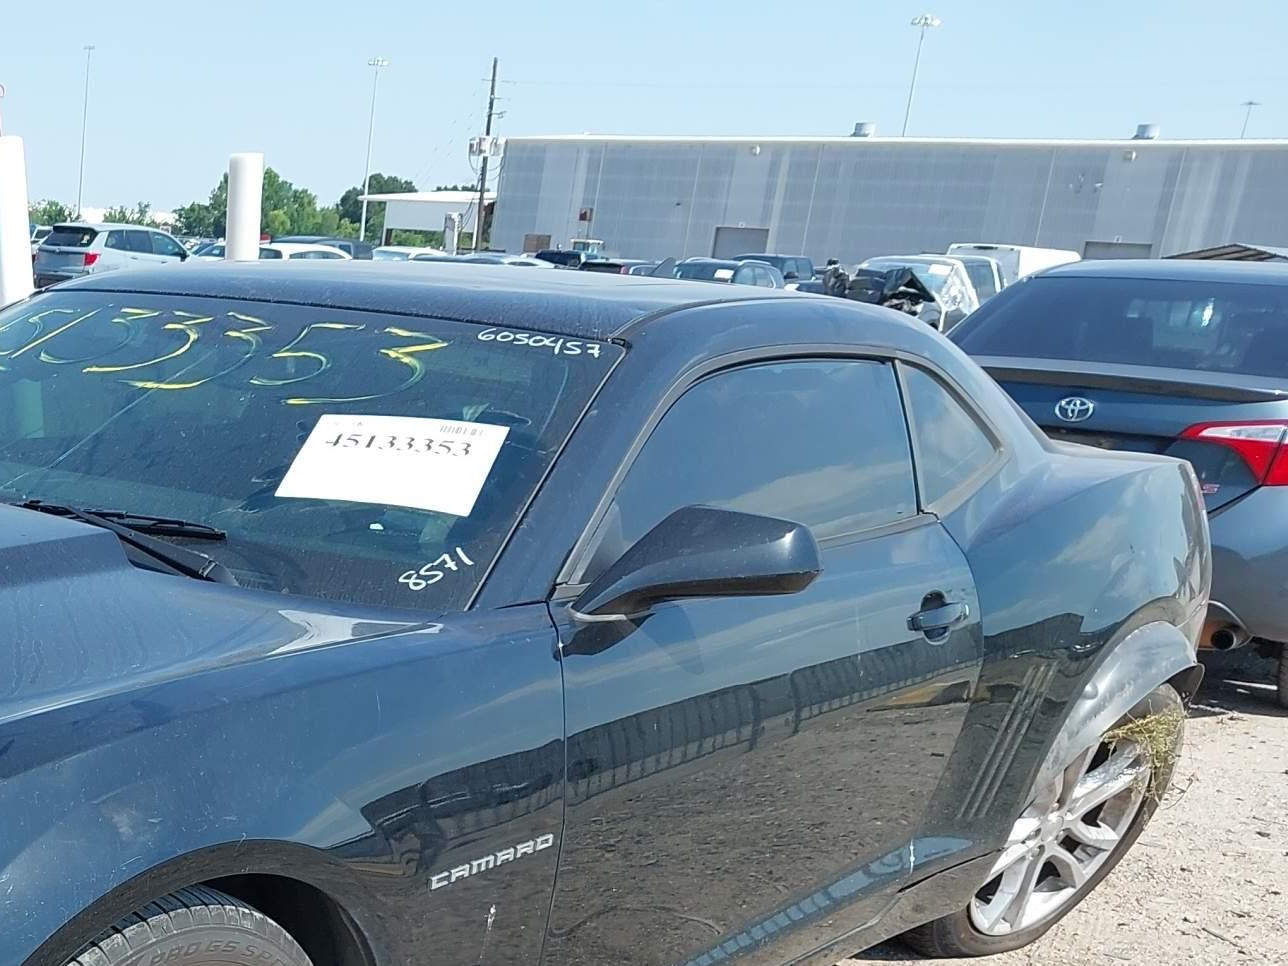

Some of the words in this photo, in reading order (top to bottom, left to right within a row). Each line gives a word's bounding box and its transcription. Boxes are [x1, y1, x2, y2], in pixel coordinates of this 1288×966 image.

[477, 328, 601, 358] 6050457
[324, 432, 473, 457] 45133353
[398, 546, 474, 591] 8571
[430, 833, 554, 890] CAMARO
